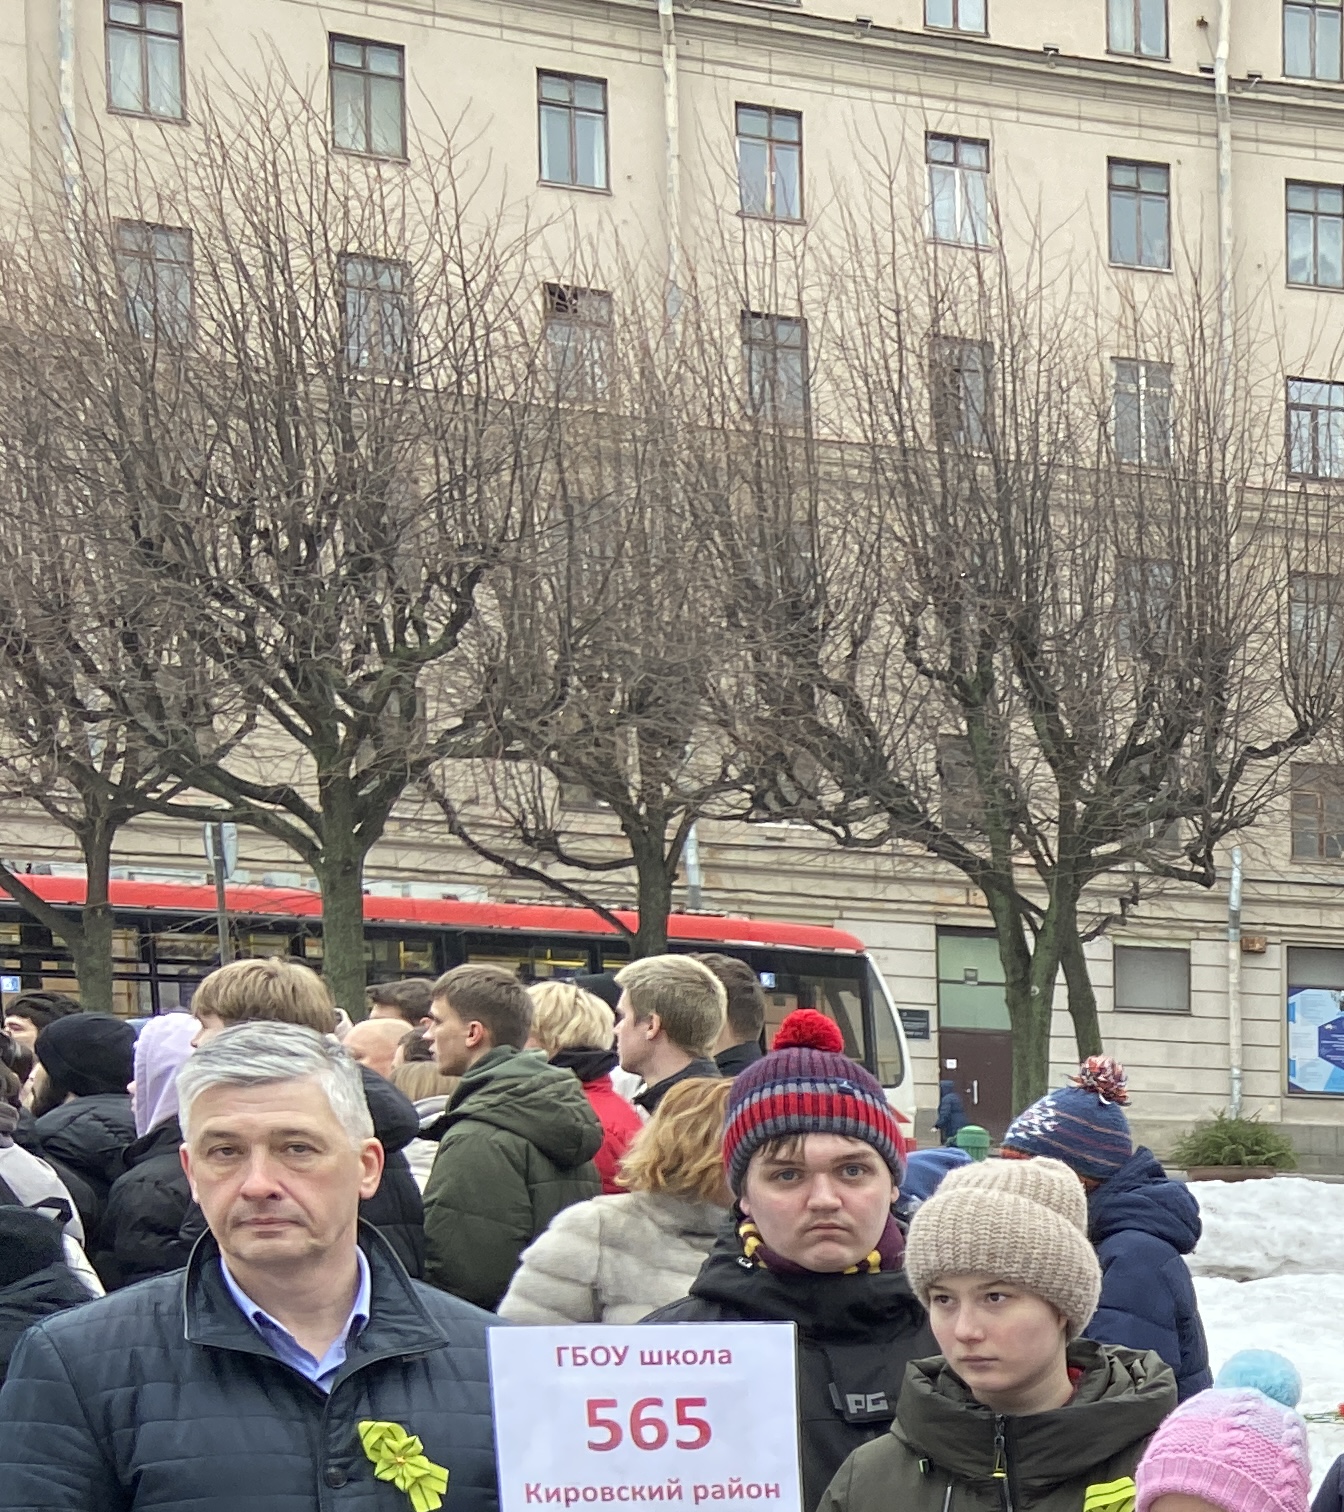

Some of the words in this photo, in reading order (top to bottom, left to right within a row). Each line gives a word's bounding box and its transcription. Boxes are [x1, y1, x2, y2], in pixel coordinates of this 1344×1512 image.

[556, 1345, 629, 1367] ГБОУ
[640, 1345, 732, 1366] школа
[846, 1391, 888, 1414] PG
[586, 1396, 713, 1451] 565
[525, 1480, 683, 1506] Кировский
[693, 1480, 781, 1505] район
